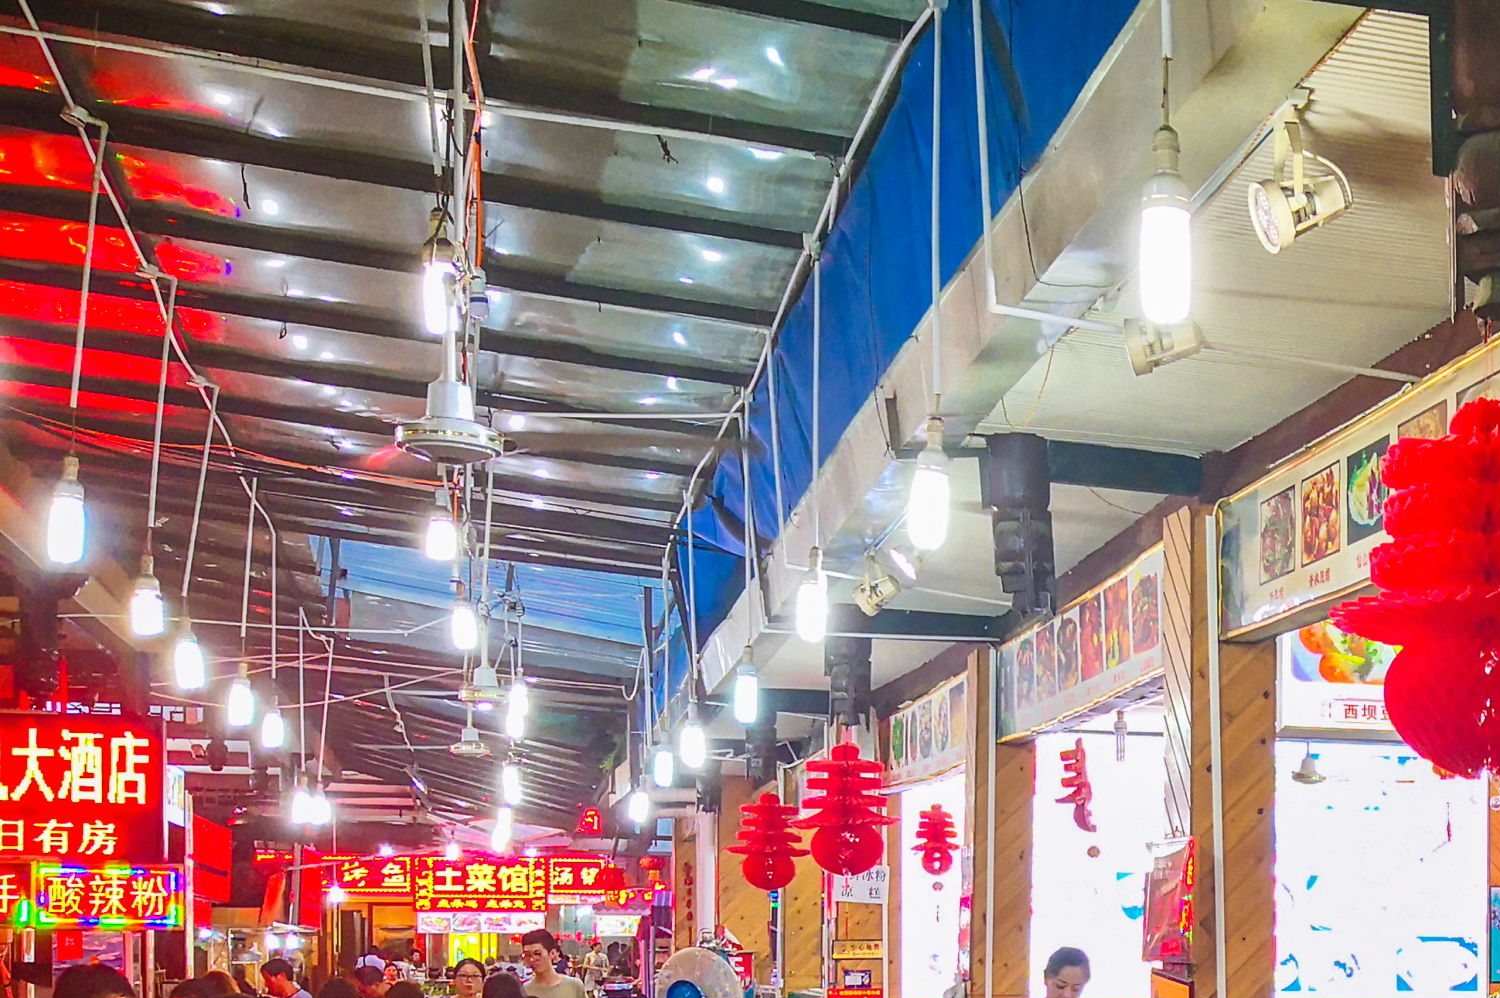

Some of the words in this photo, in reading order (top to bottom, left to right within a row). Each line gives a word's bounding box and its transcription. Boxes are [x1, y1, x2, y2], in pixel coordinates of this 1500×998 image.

[47, 873, 168, 917] 酸辣粉
[433, 865, 531, 893] 土菜馆
